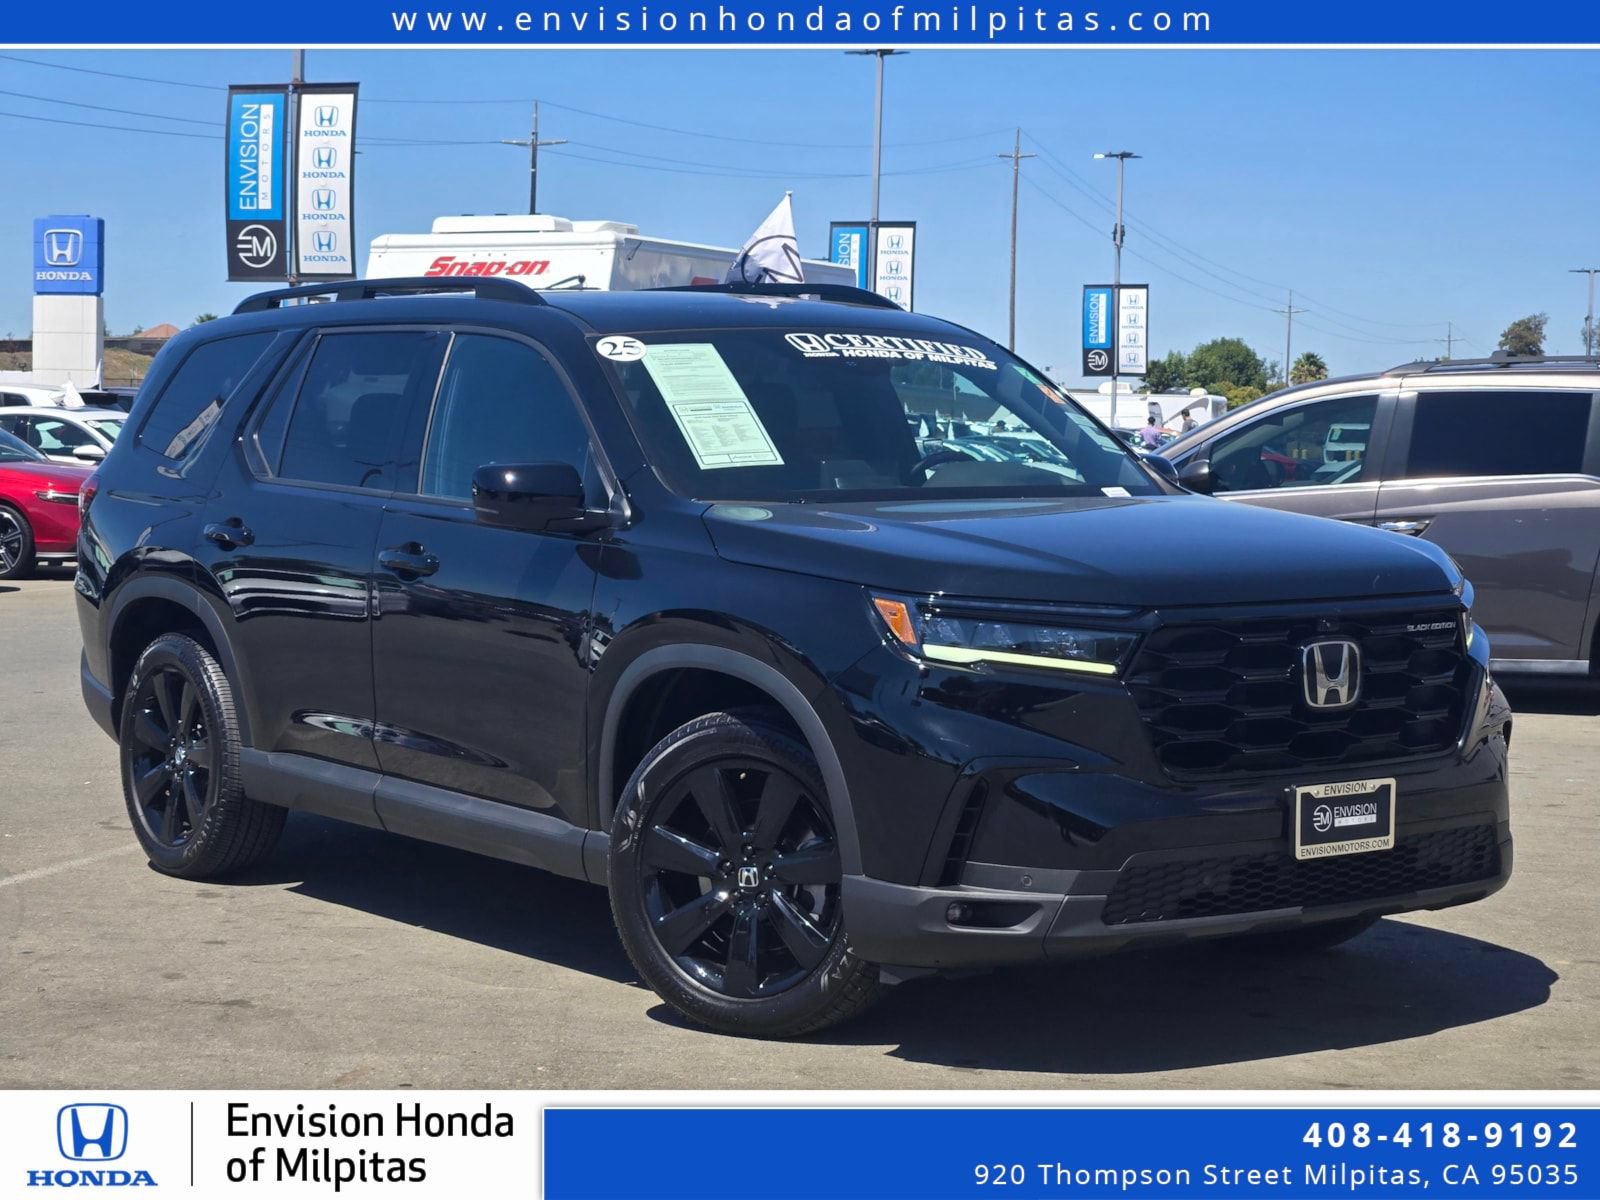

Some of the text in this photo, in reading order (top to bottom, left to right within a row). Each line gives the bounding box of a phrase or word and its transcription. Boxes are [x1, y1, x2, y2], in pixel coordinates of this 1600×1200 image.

[239, 103, 259, 210] ENVISION
[261, 113, 271, 200] MOTORS
[36, 271, 93, 281] HONDA
[424, 256, 550, 276] Snap-on
[1089, 293, 1100, 344] ENVISION
[601, 340, 642, 356] 25
[823, 333, 987, 361] CERTIFIED
[842, 349, 998, 370] HONDA OF MILPITAS
[1324, 782, 1368, 796] ENVISION
[1334, 803, 1377, 818] ENVISION
[1300, 838, 1390, 857] ENVISIONMOTORS.COM
